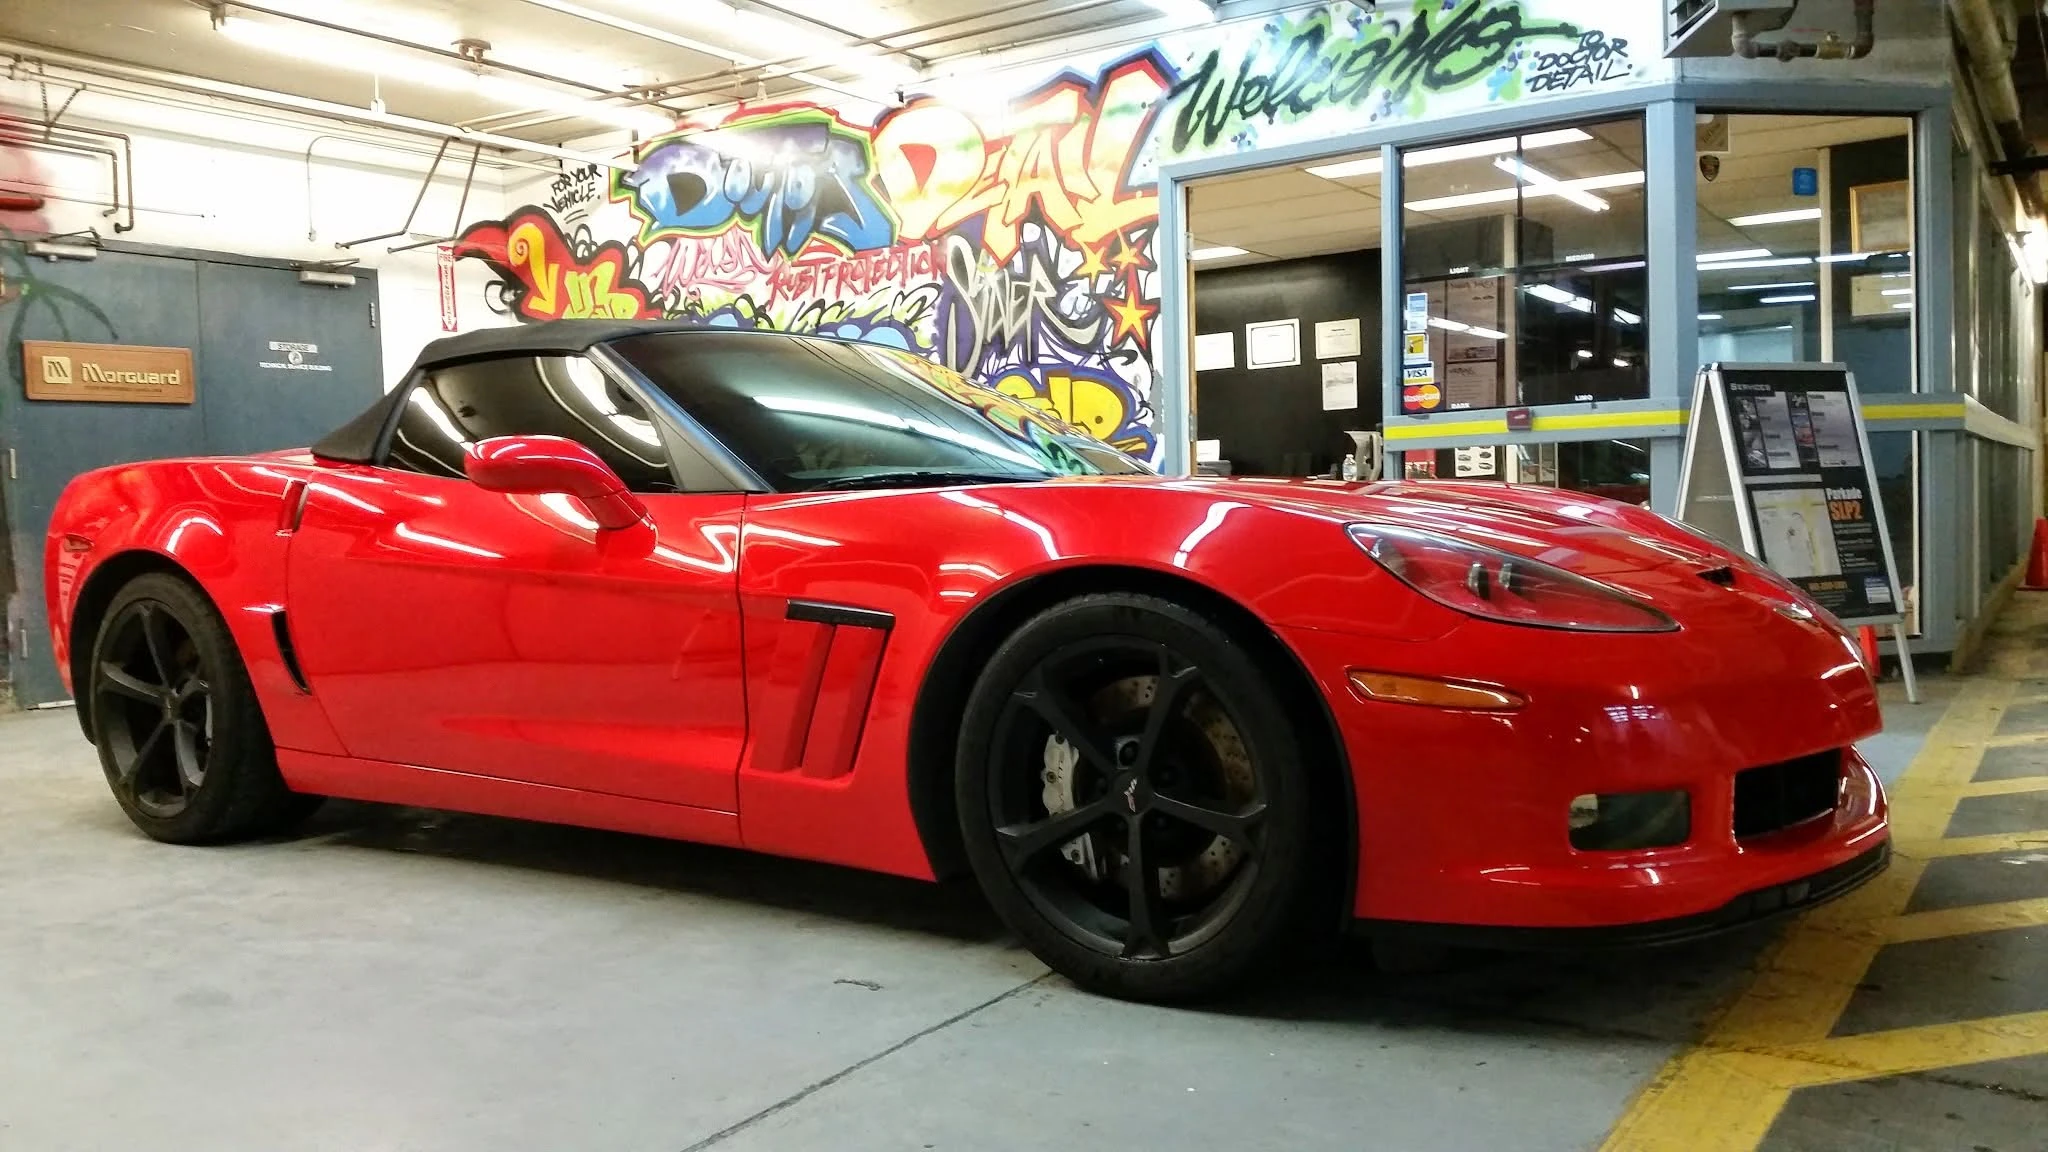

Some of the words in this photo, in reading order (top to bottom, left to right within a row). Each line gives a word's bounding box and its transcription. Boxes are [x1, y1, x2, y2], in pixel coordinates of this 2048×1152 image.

[1537, 37, 1629, 72] DOCTOR
[551, 173, 572, 197] FOR
[570, 163, 603, 187] YOUR
[821, 241, 948, 301] PROTECTION
[1449, 266, 1470, 275] LIGHT
[82, 362, 181, 385] Morguard
[1408, 369, 1428, 378] VISA
